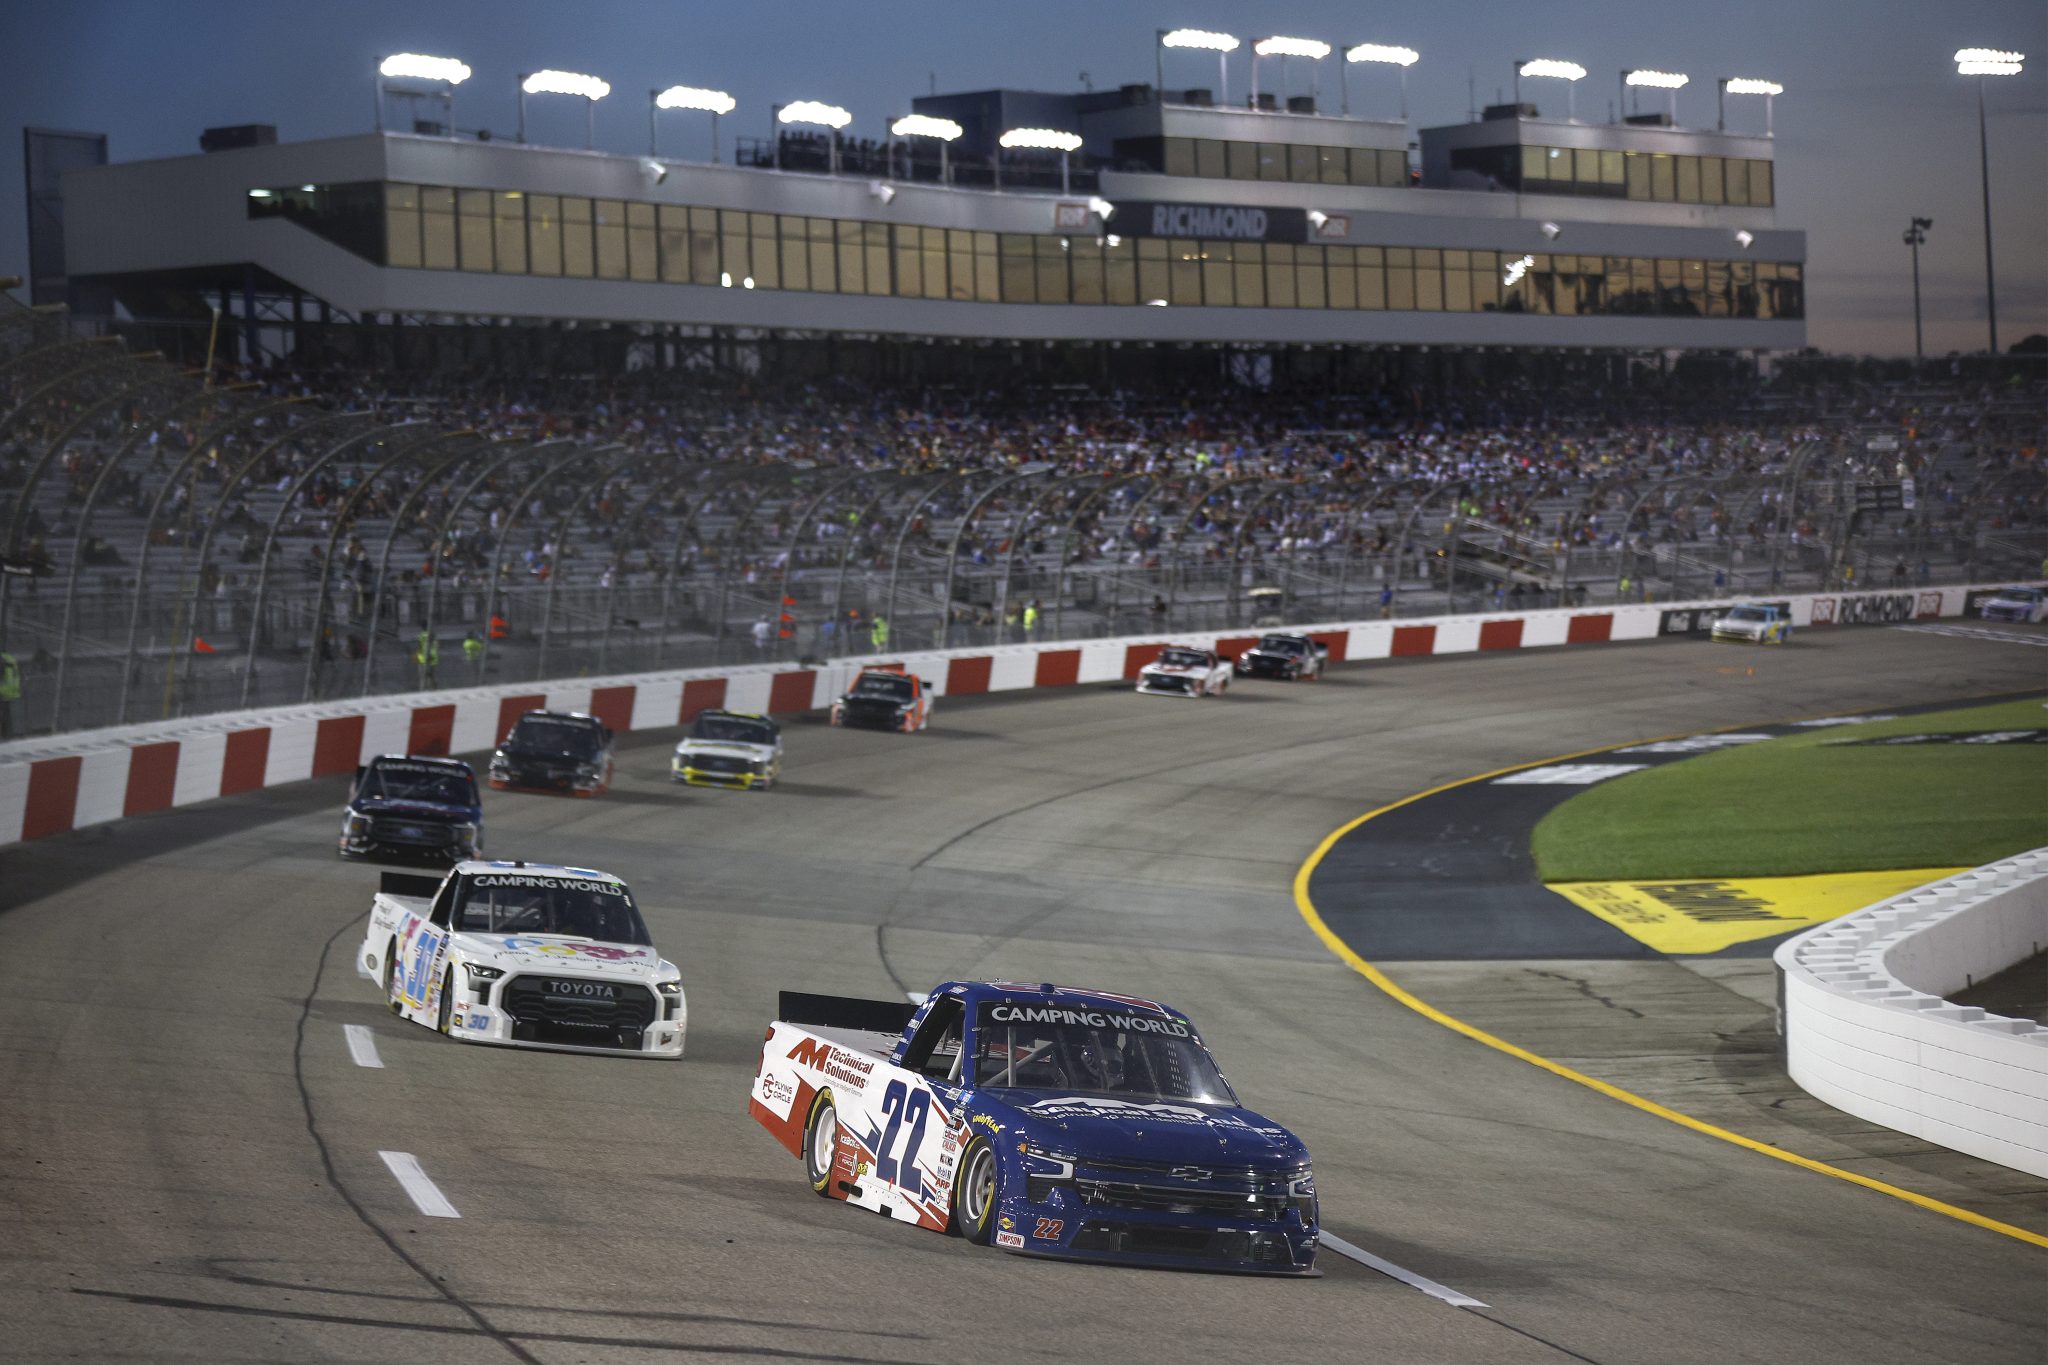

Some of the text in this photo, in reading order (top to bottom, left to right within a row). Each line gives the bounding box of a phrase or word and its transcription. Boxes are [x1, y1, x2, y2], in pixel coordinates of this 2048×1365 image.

[1152, 204, 1268, 238] RICHMOND
[1839, 594, 1915, 625] RICHMOND
[474, 876, 623, 897] CAMPING WORLD
[550, 981, 615, 998] TOYOTA
[467, 1014, 489, 1031] 30
[991, 1006, 1190, 1038] CAMPING WORLD
[829, 1047, 875, 1075] Technical
[824, 1061, 867, 1090] Solutions
[772, 1090, 791, 1104] CIRCLE
[774, 1080, 793, 1094] FLYING
[972, 1115, 1000, 1134] GOODYEAR
[876, 1078, 931, 1196] 22
[935, 1178, 950, 1189] ARP
[1033, 1217, 1065, 1241] 22
[998, 1233, 1022, 1247] SIMPSON
